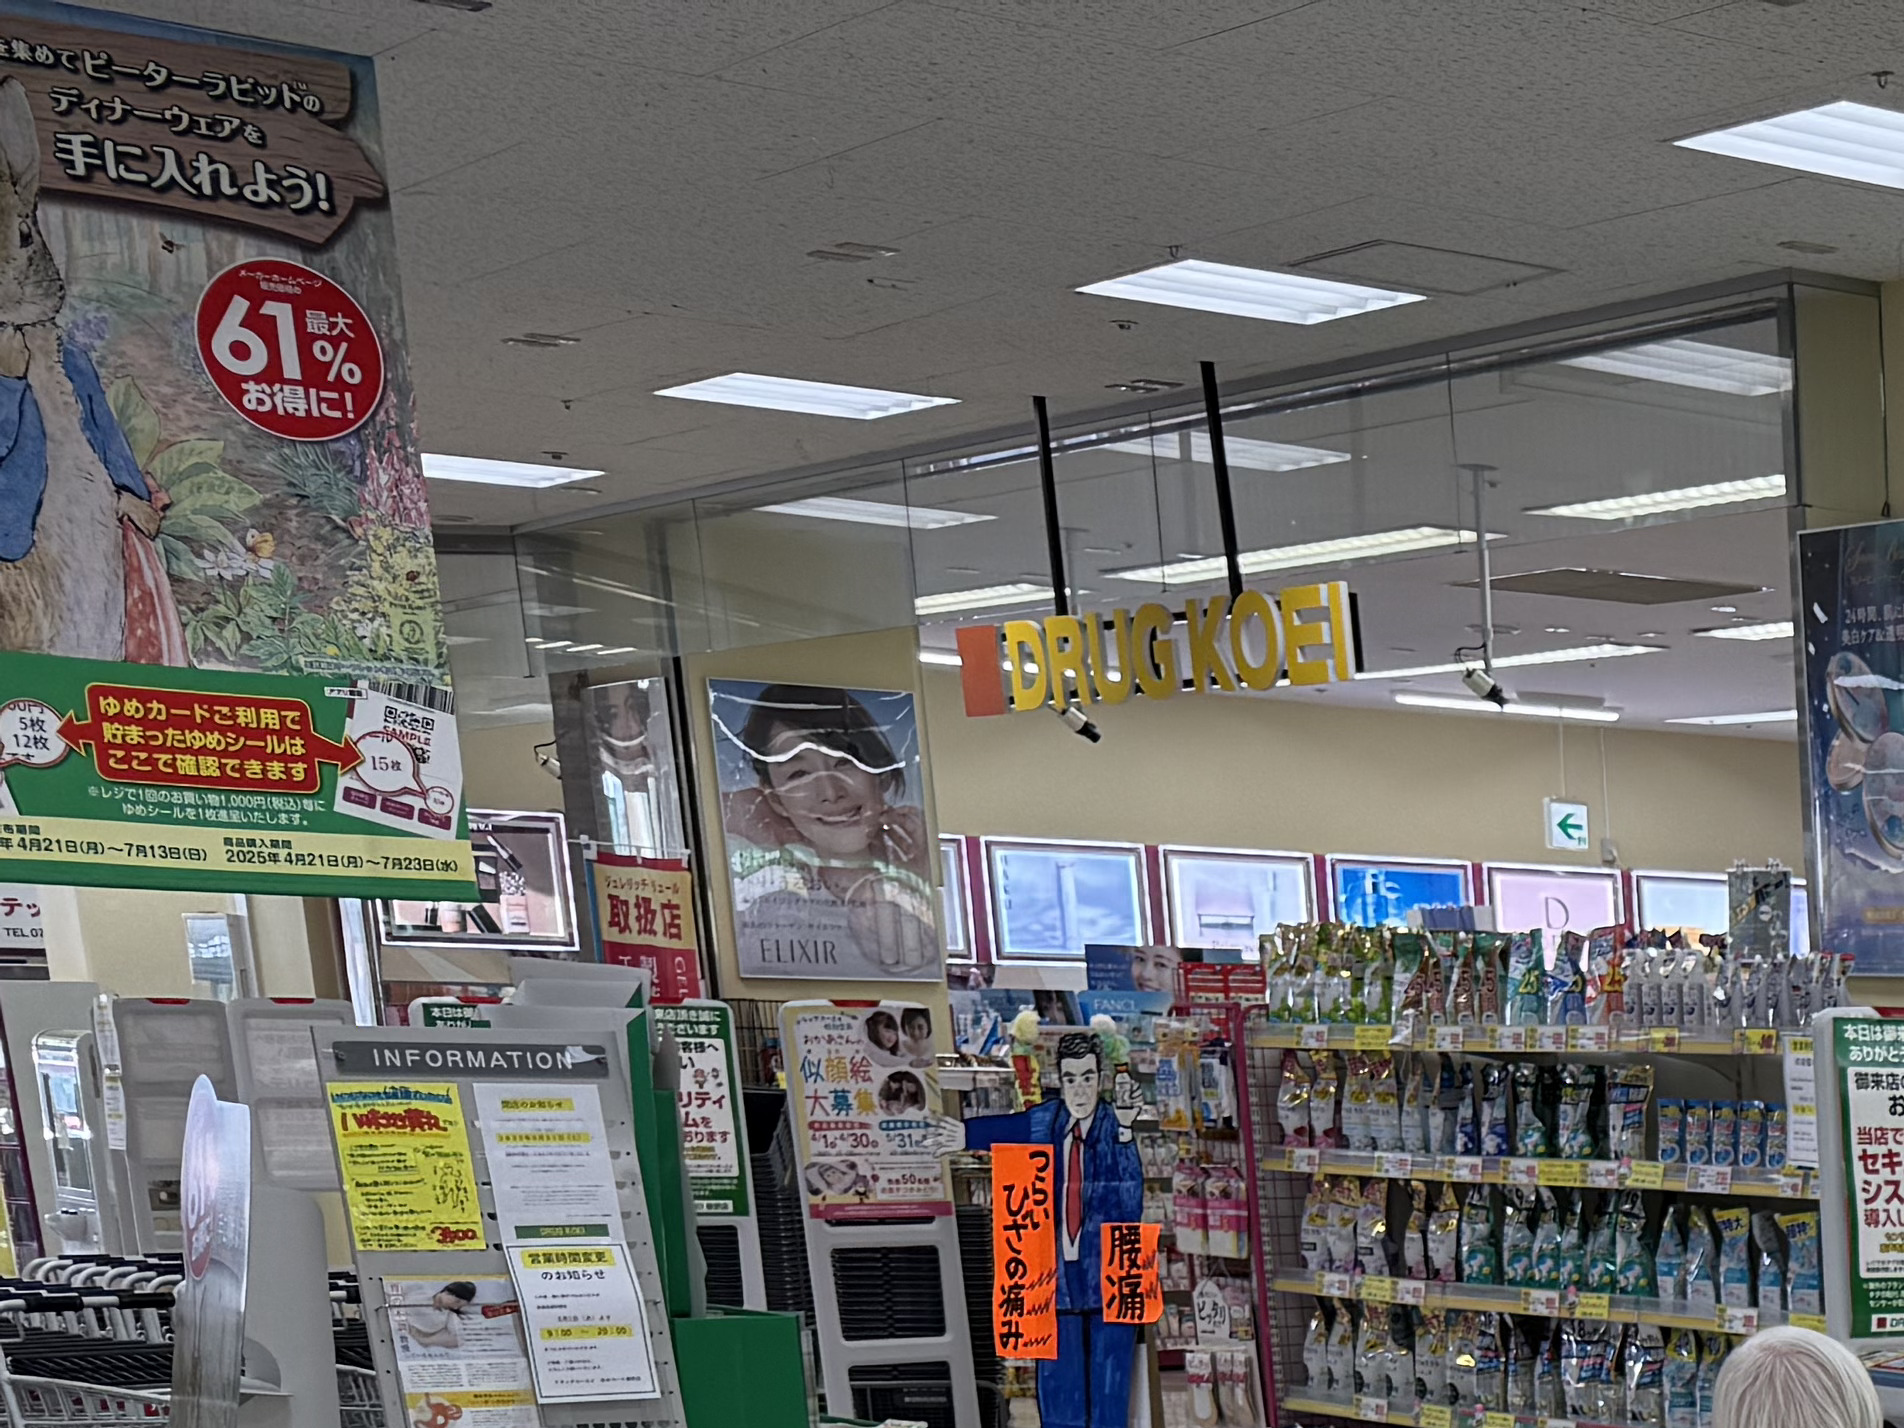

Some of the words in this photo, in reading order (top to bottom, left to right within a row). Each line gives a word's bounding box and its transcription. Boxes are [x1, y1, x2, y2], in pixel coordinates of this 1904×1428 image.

[50, 86, 265, 145] ディナーウェアを
[55, 132, 332, 212] 手に入れよう!
[305, 309, 355, 338] 最大
[241, 381, 354, 419] お得に!
[1003, 602, 1178, 712] DRUG
[1186, 581, 1356, 694] KOEI
[99, 695, 302, 731] ゆめカードご利用で
[102, 721, 307, 756] 貯まったゆめシールは
[109, 752, 308, 781] ここで確認できます
[0, 823, 41, 836] 布期間
[607, 894, 683, 941] 取扱店
[760, 938, 838, 965] ELIXIR
[653, 1008, 721, 1023] 来店頂き誠に
[1093, 998, 1137, 1011] FANCL
[373, 1048, 575, 1071] INFORMATION
[677, 1041, 720, 1054] 客様へ
[800, 1055, 875, 1085] 似顔絵
[805, 1088, 878, 1117] 大募集
[1027, 1150, 1051, 1232] つらい
[528, 1251, 608, 1265] 営業時間変更
[1105, 1223, 1146, 1322] 腰痛
[541, 1269, 606, 1280] のお知らせ
